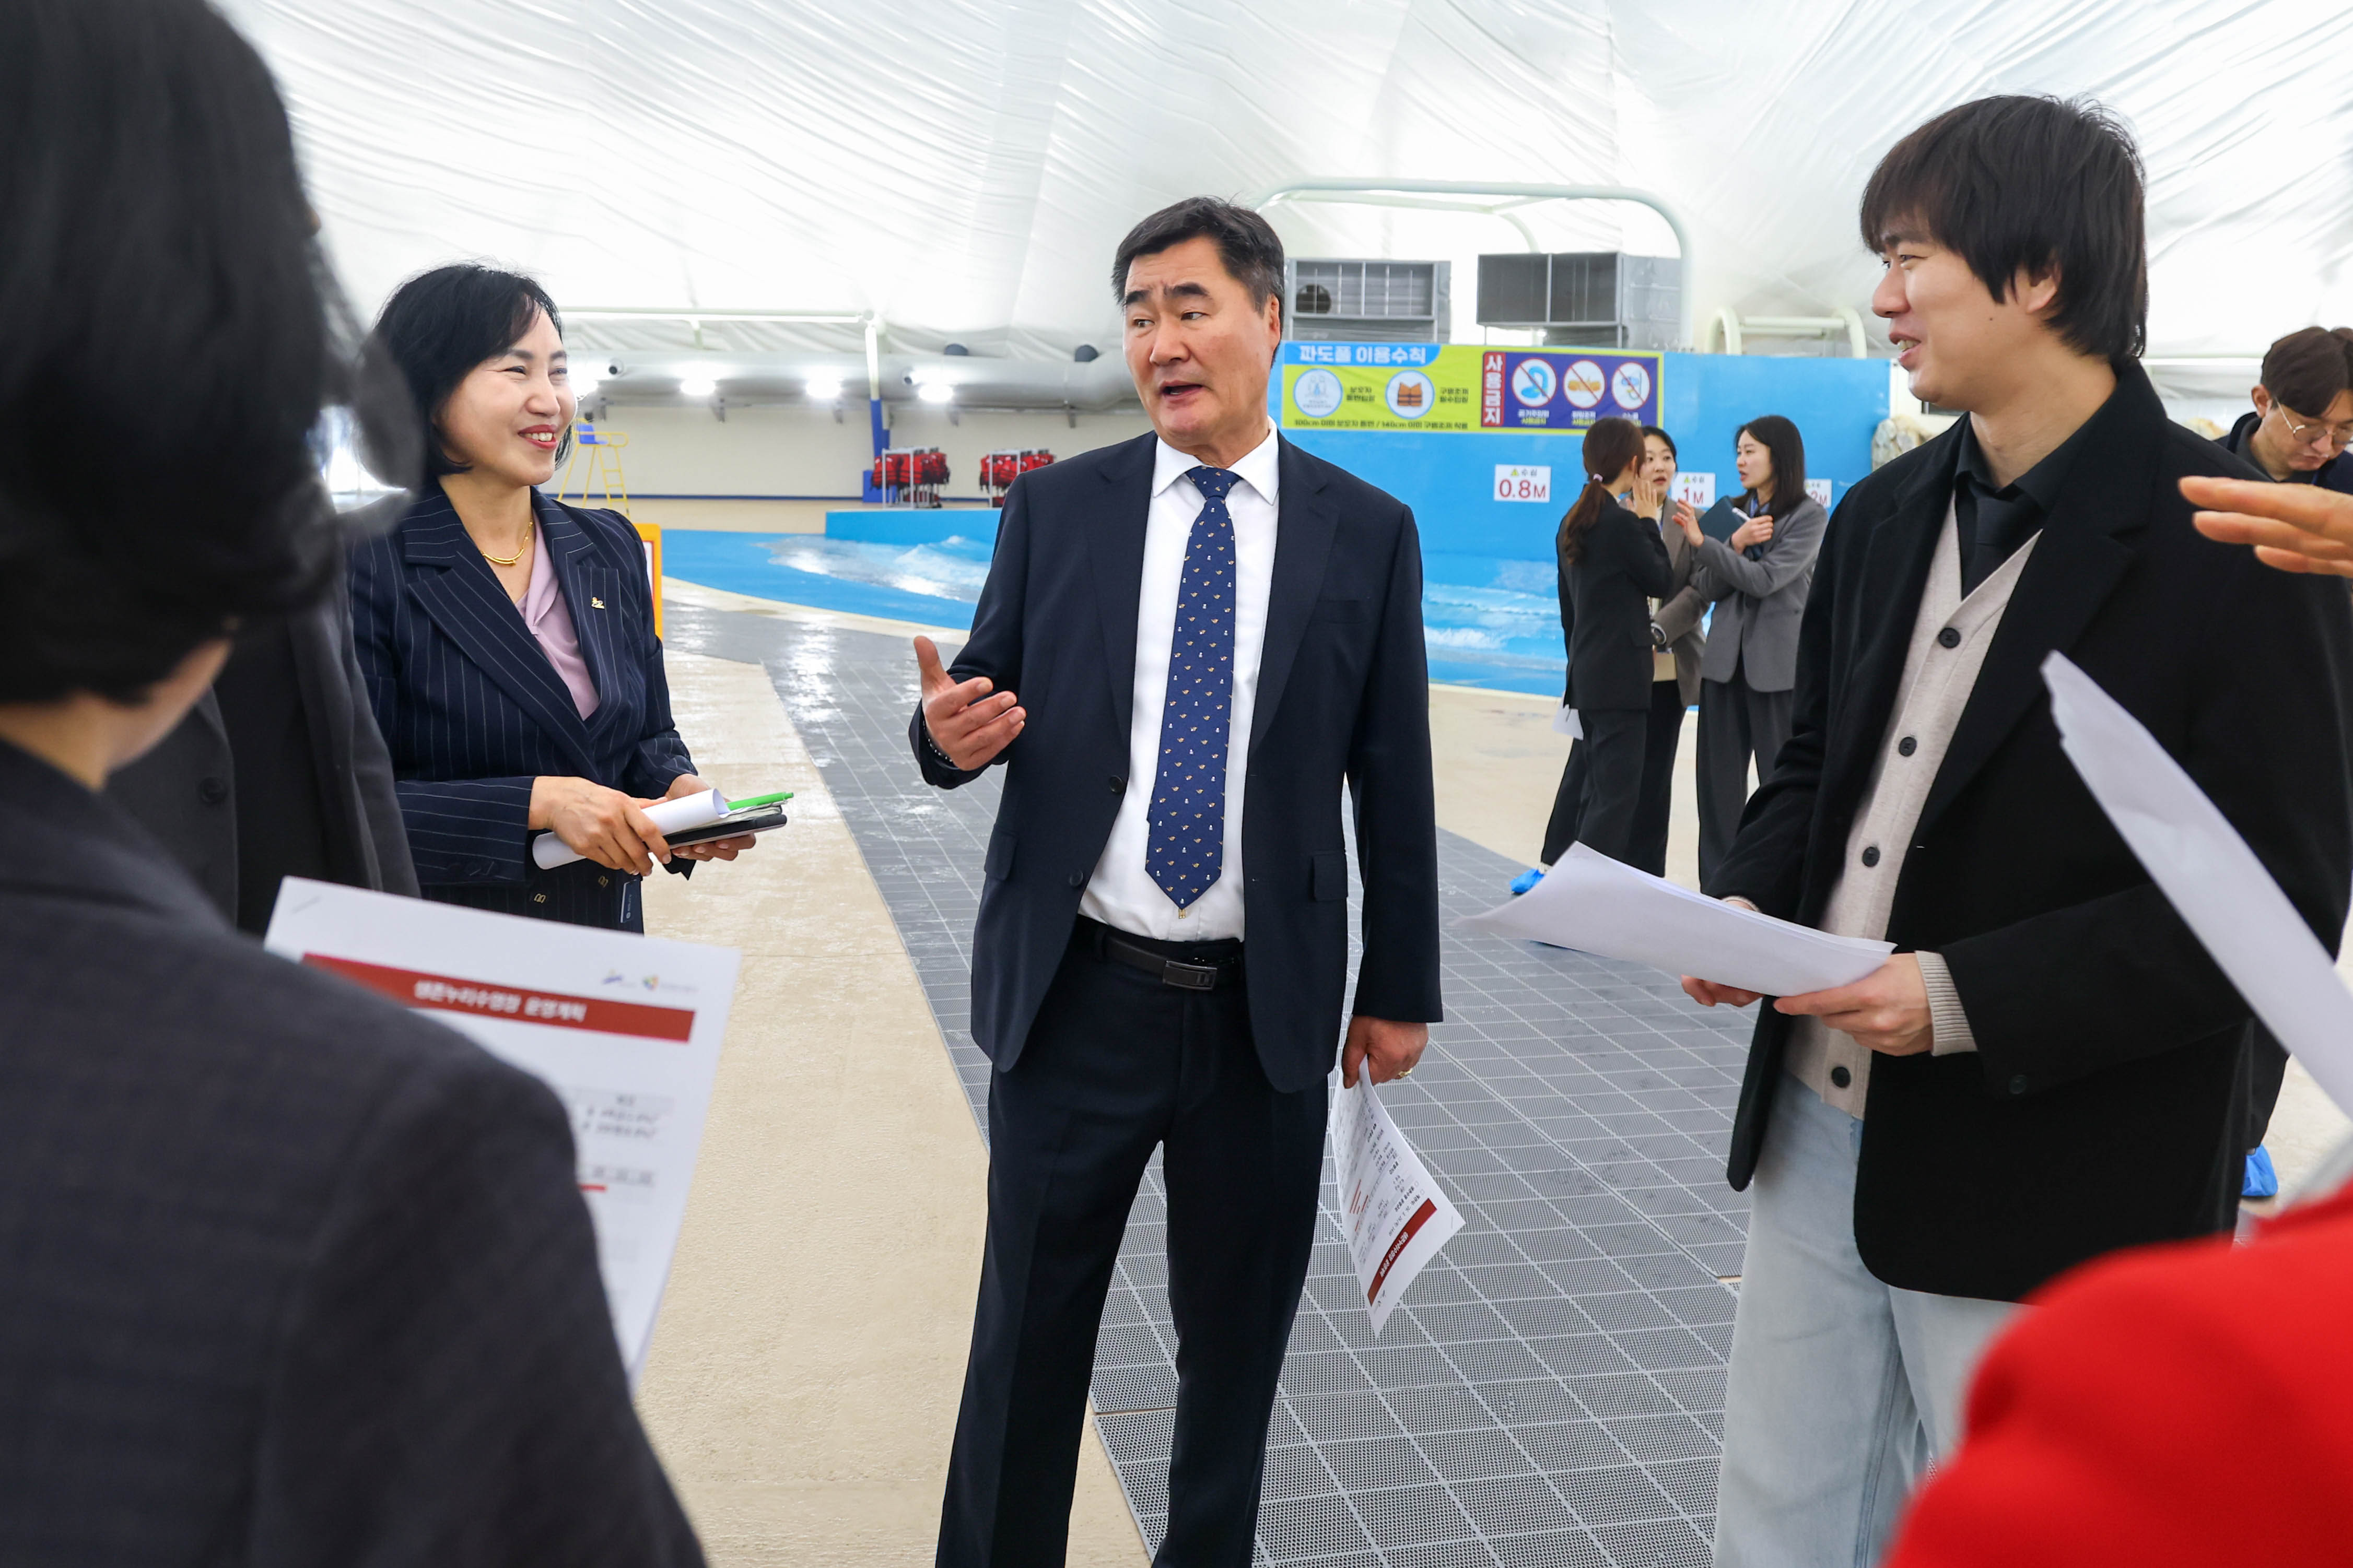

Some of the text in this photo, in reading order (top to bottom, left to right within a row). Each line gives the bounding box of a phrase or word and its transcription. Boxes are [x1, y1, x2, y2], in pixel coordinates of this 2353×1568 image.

[1300, 345, 1426, 364] 파도풀 이용수칙
[1485, 355, 1504, 425] 사용금지
[1521, 468, 1538, 477] 수심
[1499, 479, 1546, 498] 0.8M
[1683, 486, 1704, 504] 1M
